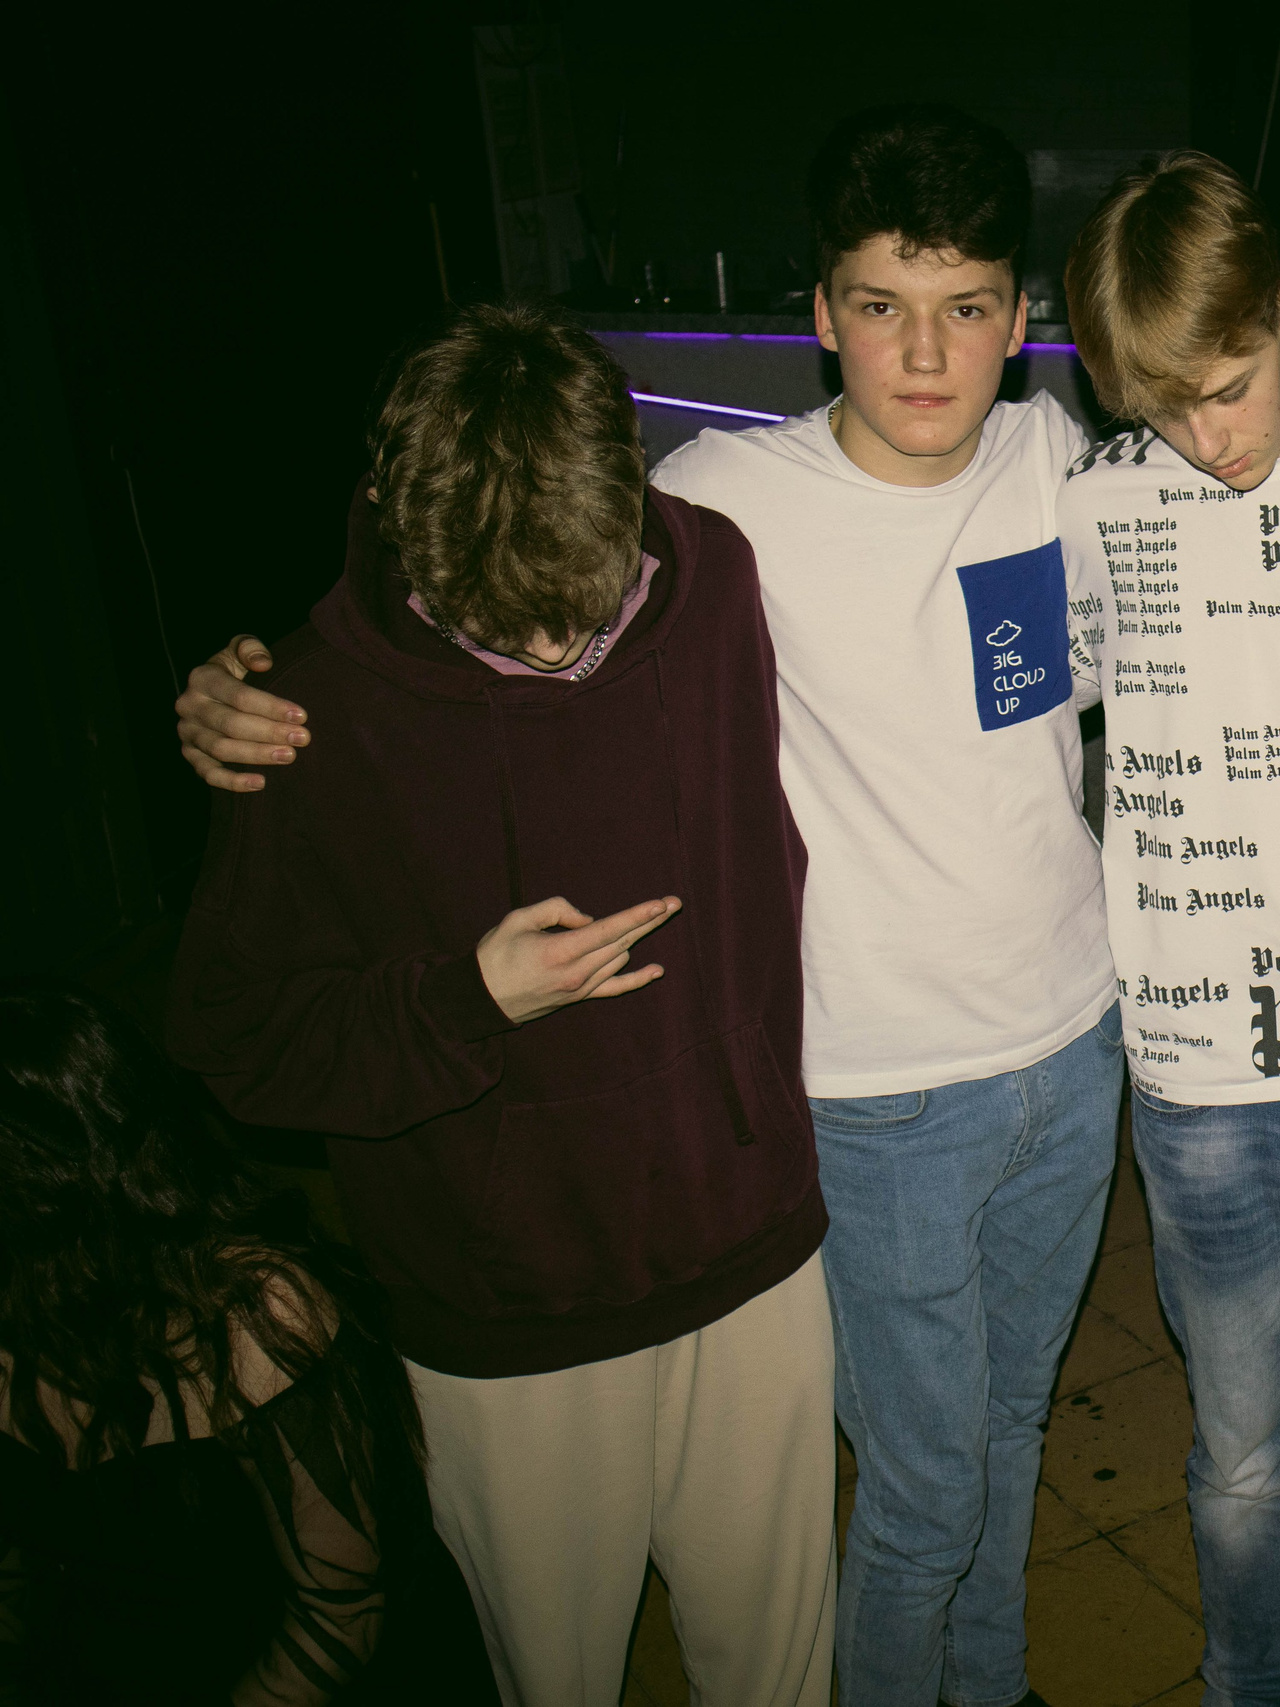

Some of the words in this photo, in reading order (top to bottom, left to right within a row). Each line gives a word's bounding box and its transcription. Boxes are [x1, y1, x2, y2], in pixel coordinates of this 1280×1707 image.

[1158, 488, 1194, 505] Palm
[1199, 486, 1244, 503] Angels
[1097, 520, 1130, 537] Palm
[1134, 518, 1177, 535] Angels
[1102, 540, 1132, 557] Palm
[1136, 538, 1177, 556] Angels
[1107, 559, 1133, 576] Palm
[1136, 558, 1177, 576] Angels
[1111, 579, 1135, 596] Palm
[1138, 578, 1179, 596] Angels
[1069, 592, 1103, 620] ngels
[1115, 599, 1137, 616] Palm
[1140, 599, 1180, 617] Angels
[1206, 600, 1243, 617] Palm
[1117, 619, 1138, 636] Palm
[1141, 620, 1182, 637] Angels
[1115, 659, 1142, 676] Palm
[1146, 660, 1186, 677] Angels
[1115, 679, 1145, 697] Palm
[1149, 679, 1188, 697] Angels
[995, 697, 1020, 715] UP
[1222, 726, 1259, 743] Palm
[1120, 745, 1202, 780] Angels
[1224, 745, 1260, 762] Palm
[1226, 765, 1262, 782] Palm
[1112, 785, 1184, 819] Angels
[1134, 829, 1173, 859] Palm
[1180, 836, 1258, 864] Angels
[1137, 881, 1178, 912] Palm
[1185, 887, 1265, 916] Angels
[1135, 974, 1230, 1010] Angels
[1138, 1028, 1170, 1041] Palm
[1172, 1032, 1213, 1047] Angels
[1141, 1046, 1180, 1064] Angels
